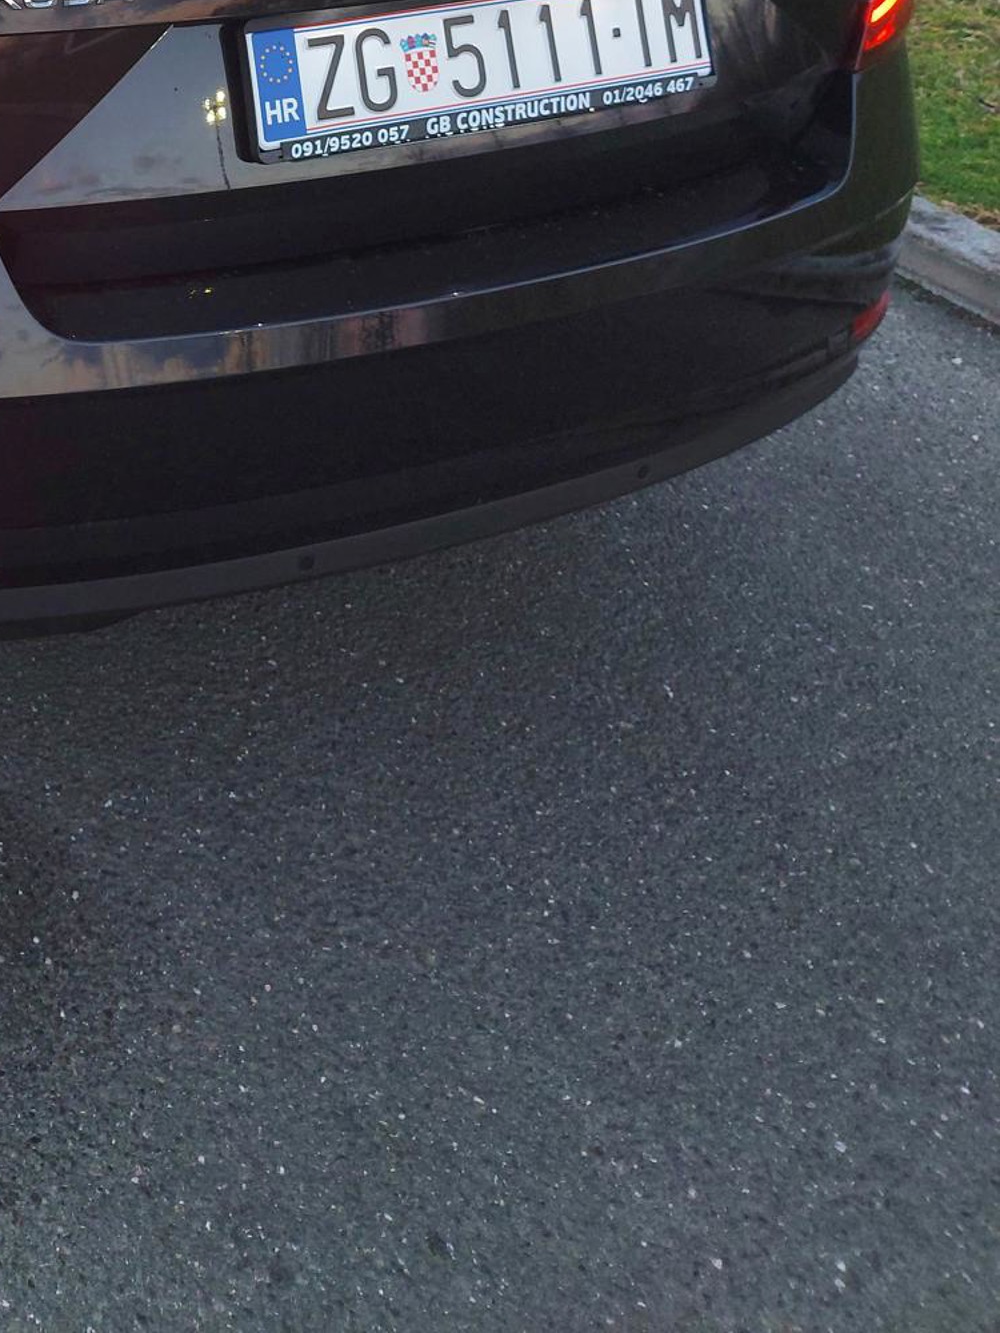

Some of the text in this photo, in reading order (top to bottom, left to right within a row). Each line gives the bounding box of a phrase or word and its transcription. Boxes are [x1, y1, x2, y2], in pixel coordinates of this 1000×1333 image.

[264, 97, 301, 126] HR
[307, 27, 398, 121] ZG
[290, 76, 695, 159] 091/9520 057 GB CONSTRUCTION 01/2046 467
